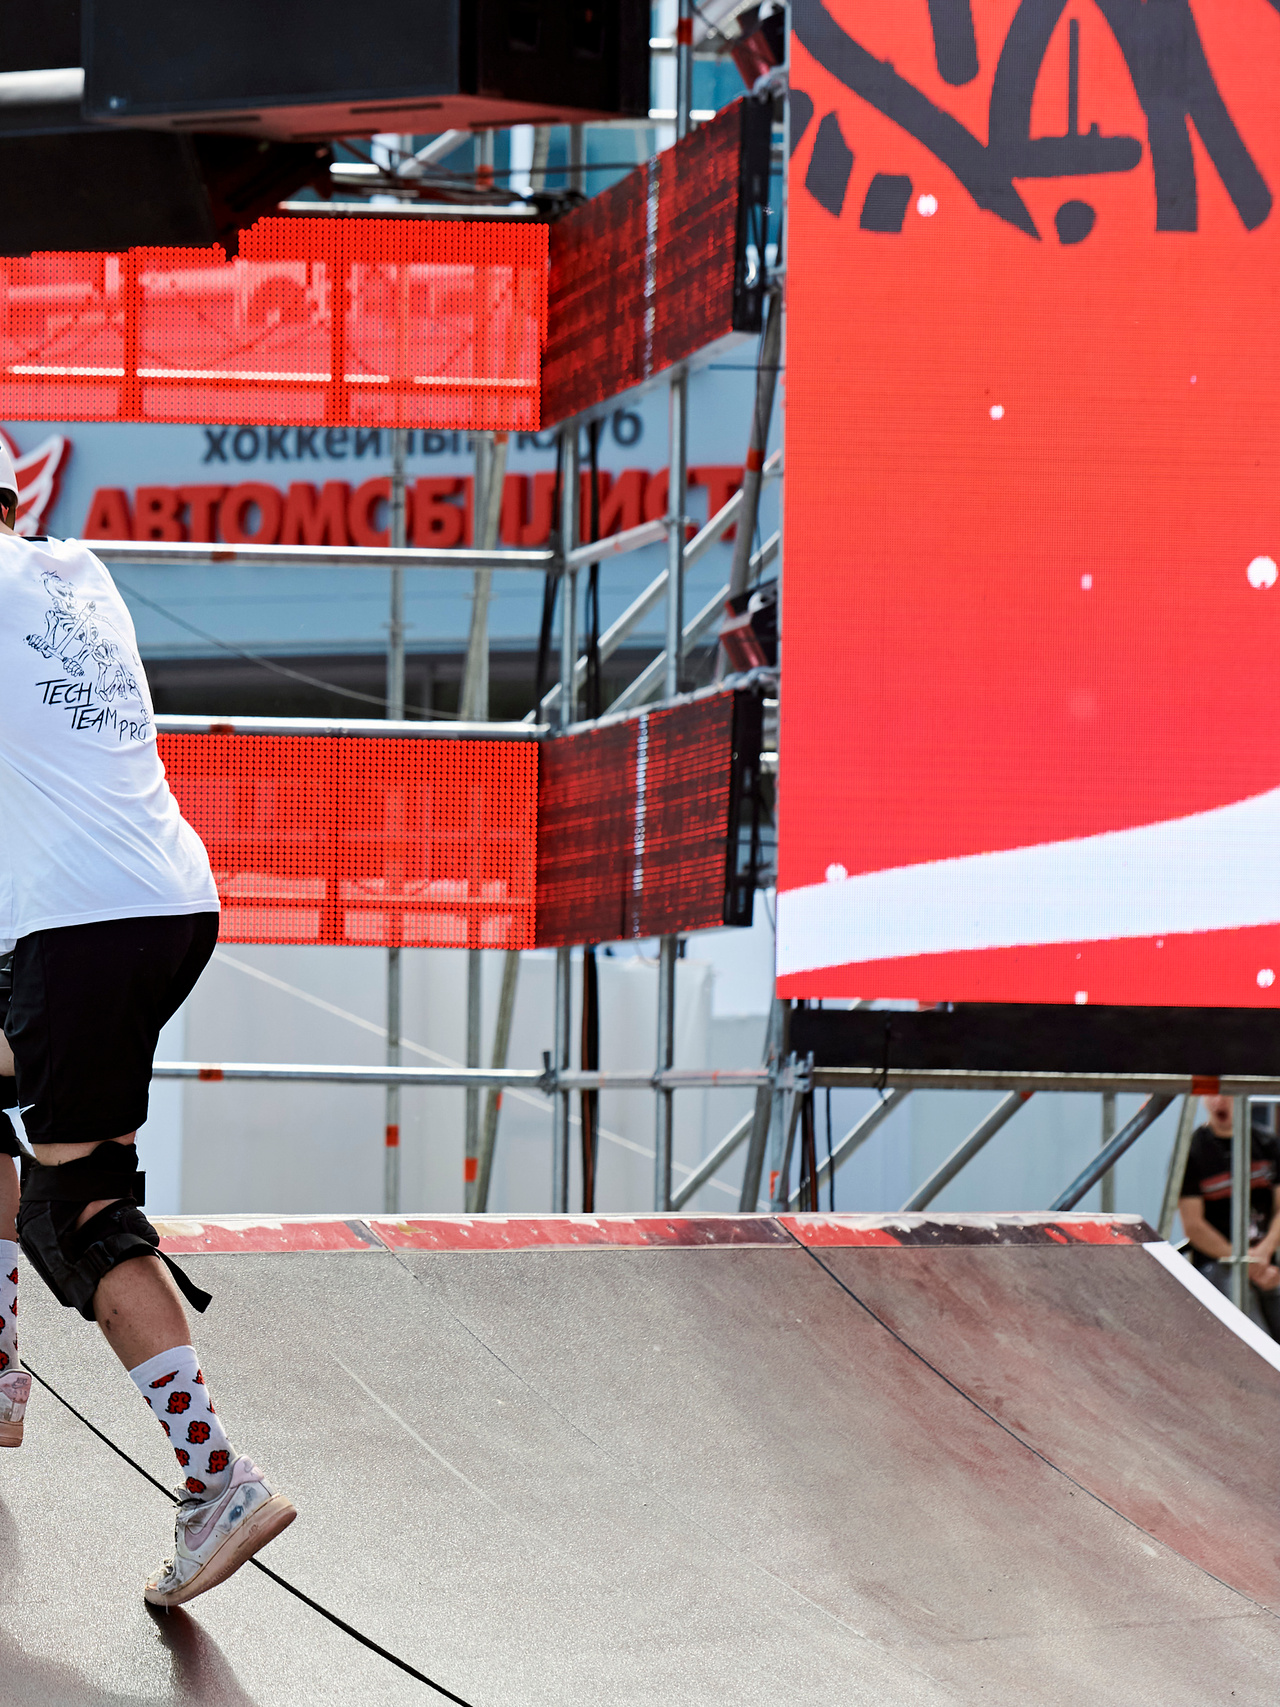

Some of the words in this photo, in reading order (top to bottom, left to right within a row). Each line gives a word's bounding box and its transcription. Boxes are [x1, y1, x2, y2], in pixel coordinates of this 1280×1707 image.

[204, 427, 476, 463] хоккейы
[35, 679, 93, 706] TECH
[64, 704, 117, 733] TEAM
